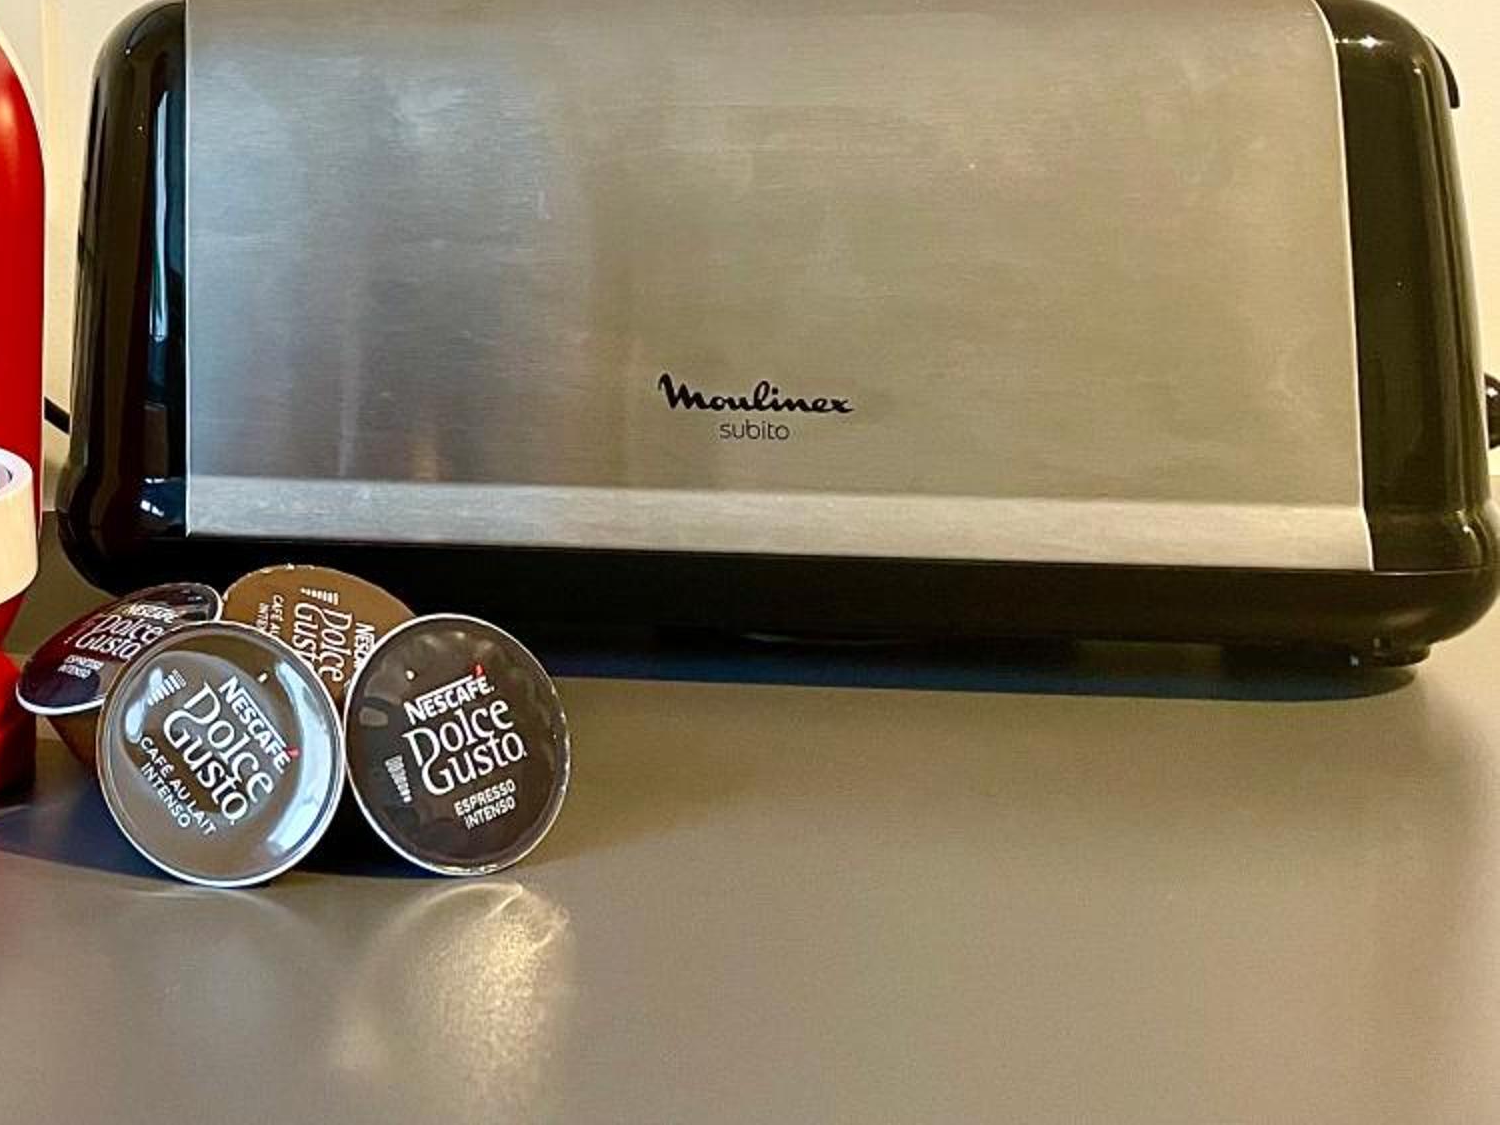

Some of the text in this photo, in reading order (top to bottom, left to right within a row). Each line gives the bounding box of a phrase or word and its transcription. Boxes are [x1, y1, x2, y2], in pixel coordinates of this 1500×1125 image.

[658, 373, 854, 413] Moulinex
[720, 419, 790, 440] subito
[76, 632, 142, 660] Gusto
[92, 615, 165, 644] Dolce
[292, 603, 323, 662] Gust
[318, 608, 352, 682] Dolce
[184, 682, 274, 803] Dolce
[402, 699, 513, 766] Dolce
[141, 736, 217, 835] CAFÉ AU LAIT
[164, 709, 248, 821] Gusto
[422, 732, 525, 795] Gusto
[141, 763, 192, 828] INTENSO
[454, 779, 516, 816] ESPRESSO
[463, 797, 515, 830] INTENSO
